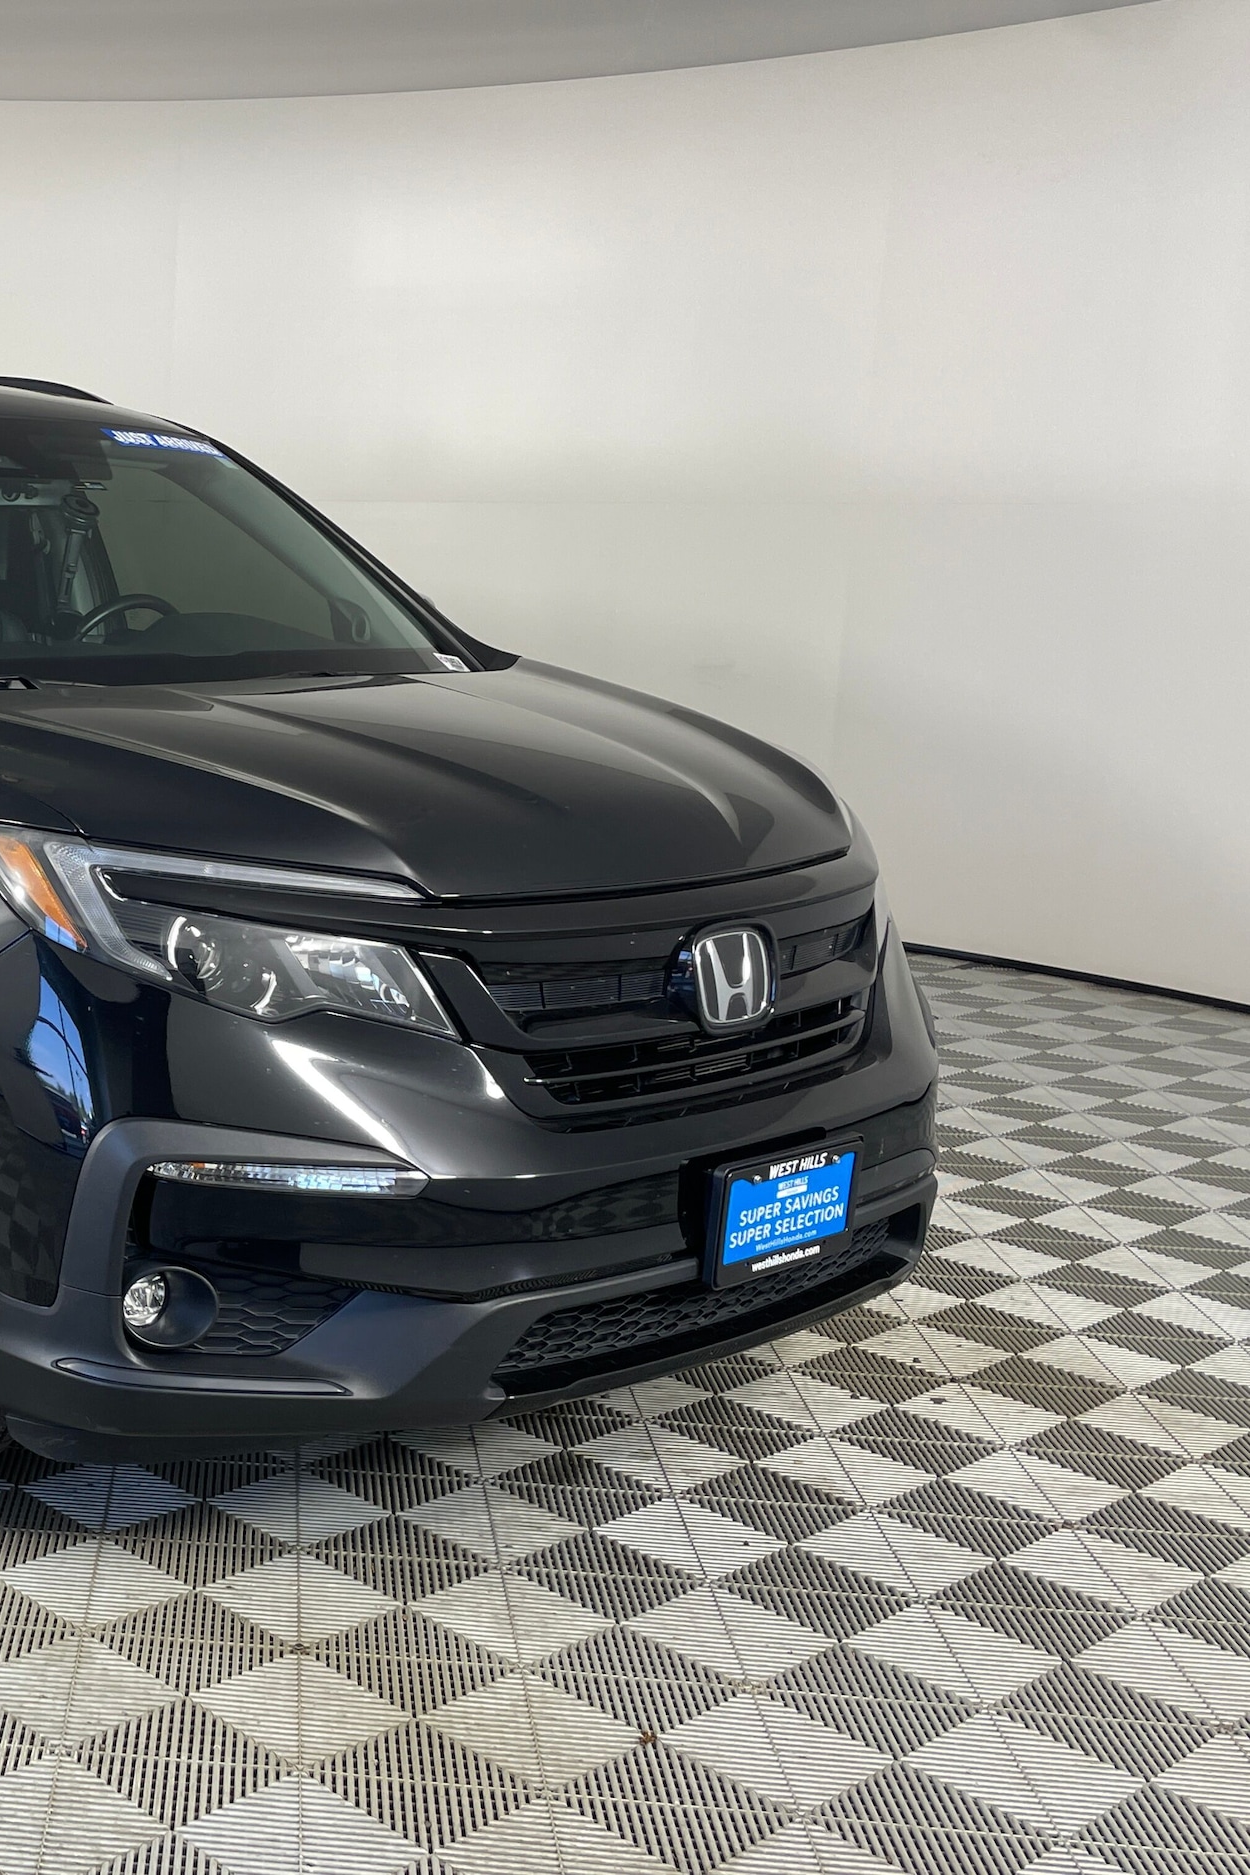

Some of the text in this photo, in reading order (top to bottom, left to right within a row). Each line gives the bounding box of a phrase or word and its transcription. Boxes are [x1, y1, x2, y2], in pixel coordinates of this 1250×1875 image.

[111, 430, 157, 446] JUST
[769, 1153, 828, 1180] WEST HILLS
[777, 1176, 809, 1191] WEST HILLS
[739, 1186, 840, 1227] SUPER SAVINGS
[729, 1203, 844, 1249] SUPER SELECTION
[752, 1245, 820, 1272] westhillshonda.com
